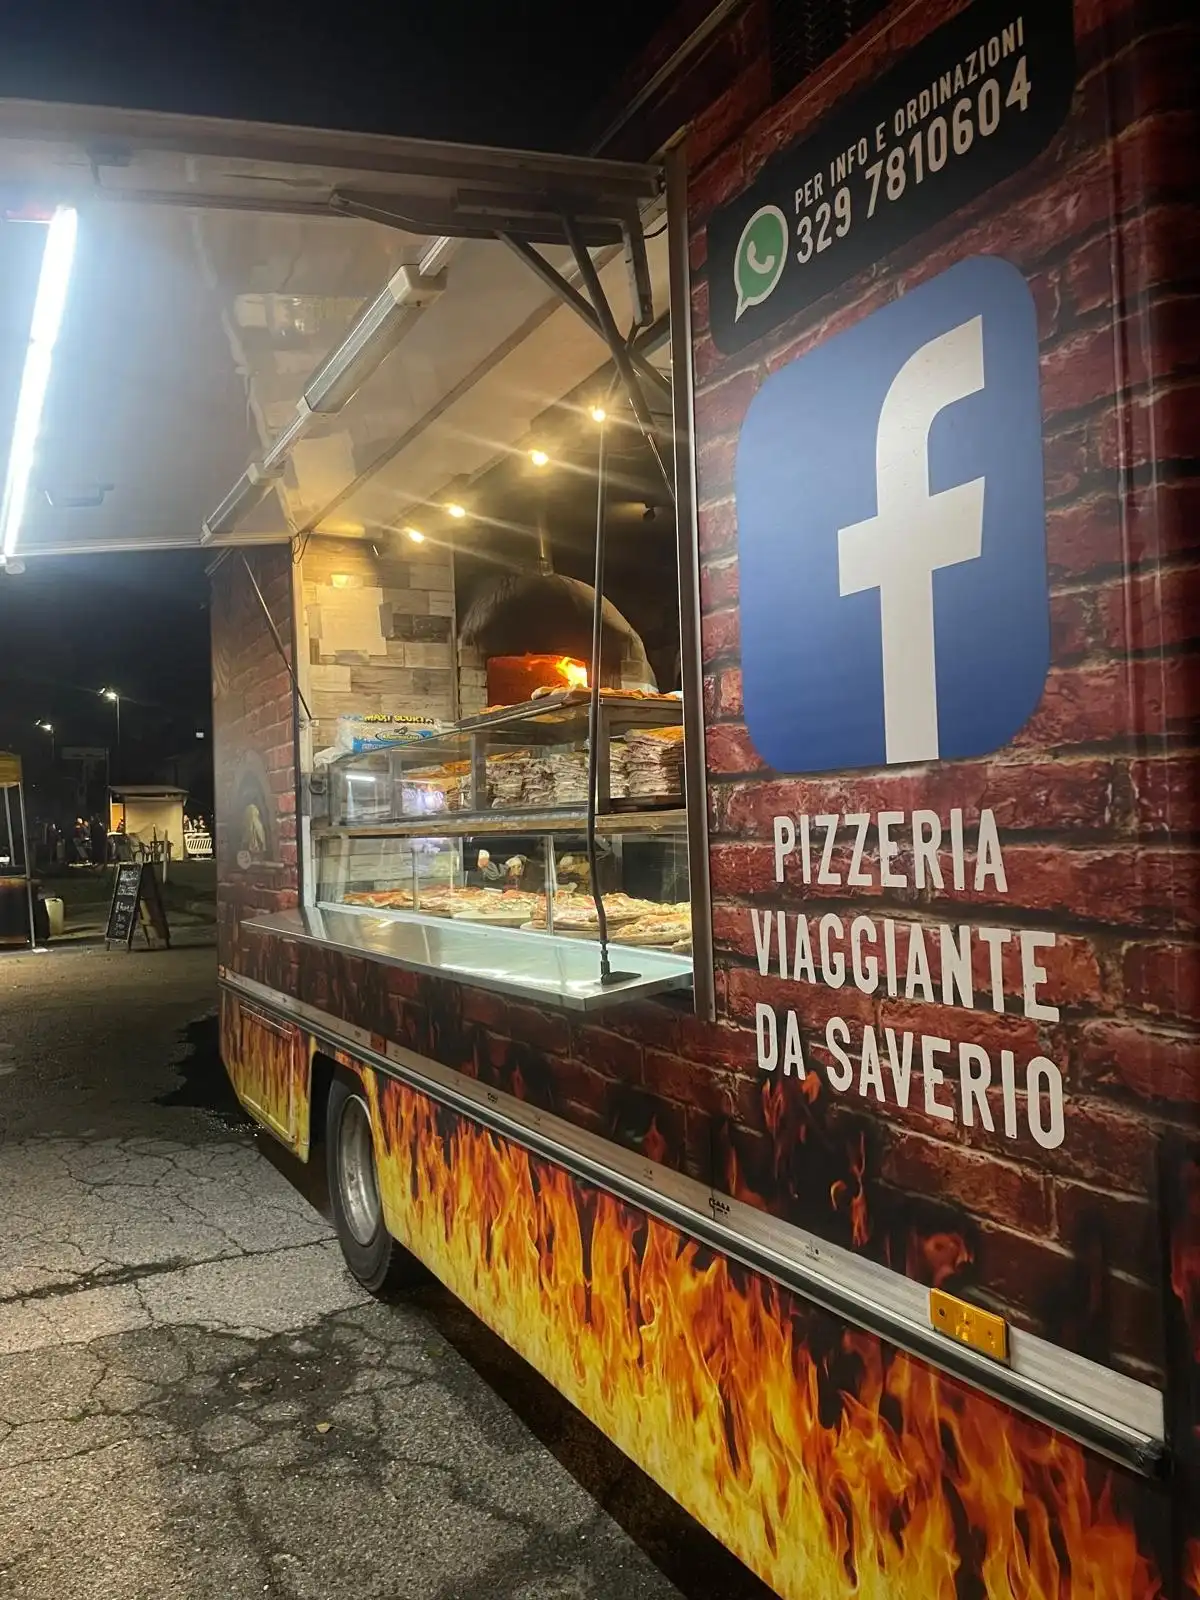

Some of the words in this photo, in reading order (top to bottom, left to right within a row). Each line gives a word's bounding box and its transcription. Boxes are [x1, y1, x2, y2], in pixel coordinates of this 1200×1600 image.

[795, 173, 824, 214] PER
[831, 138, 868, 185] INFO
[876, 122, 887, 151] E
[894, 16, 1024, 137] ORDINAZIONI
[796, 184, 852, 265] 329
[864, 55, 1032, 219] 7810604
[773, 807, 1009, 893] PIZZERIA
[751, 908, 1061, 1023] VIAGGIANTE
[755, 1002, 806, 1081] DA
[825, 1016, 1066, 1150] SAVERIO
